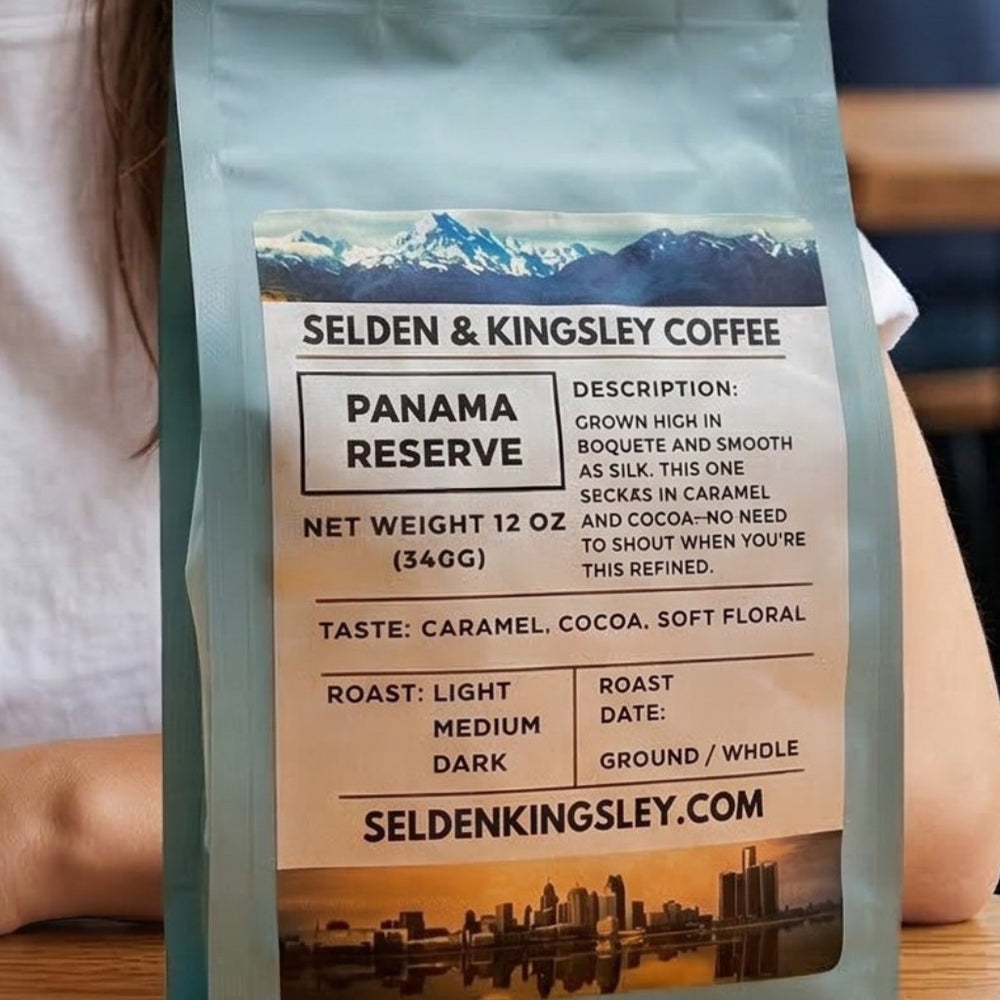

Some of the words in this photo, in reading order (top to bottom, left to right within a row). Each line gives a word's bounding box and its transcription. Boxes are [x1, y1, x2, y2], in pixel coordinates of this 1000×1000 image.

[301, 313, 440, 347] SELDEN
[449, 314, 481, 347] &
[486, 314, 656, 347] KINGSLEY
[663, 317, 782, 347] COFFEE
[572, 379, 739, 399] DESCRIPTION:
[346, 392, 519, 424] PANAMA
[574, 413, 649, 431] GROWN
[653, 413, 699, 430] HIGH
[702, 412, 723, 429] IN
[346, 436, 524, 469] RESERVE
[577, 436, 668, 457] BOQUETE
[671, 436, 712, 453] AND
[715, 435, 793, 453] SMOOTH
[578, 462, 604, 480] AS
[608, 461, 655, 479] SILK.
[658, 460, 701, 478] THIS
[704, 459, 746, 477] ONE
[658, 486, 678, 503] IN
[682, 484, 772, 502] CARAMEL
[303, 515, 362, 539] NET
[369, 513, 486, 537] WEIGHT
[492, 512, 521, 533] 12
[528, 511, 567, 533] OZ
[580, 512, 623, 530] AND
[738, 507, 788, 525] NEED
[580, 536, 607, 554] TO
[611, 534, 676, 553] SHOUT
[679, 533, 736, 551] WHEN
[740, 530, 807, 550] YOU'RE
[580, 561, 625, 579] THIS
[629, 558, 715, 578] REFINED.
[317, 619, 411, 641] TASTE:
[657, 608, 716, 629] SOFT
[722, 604, 807, 626] FLORAL
[327, 683, 424, 705] ROAST:
[433, 680, 512, 703] LIGHT
[599, 673, 675, 695] ROAST
[600, 703, 666, 725] DATE:
[433, 715, 541, 739] MEDIUM
[432, 752, 508, 774] DARK
[599, 746, 700, 771] GROUND
[704, 743, 717, 768] /
[362, 788, 764, 844] SELDENKINGSLEY.COM
